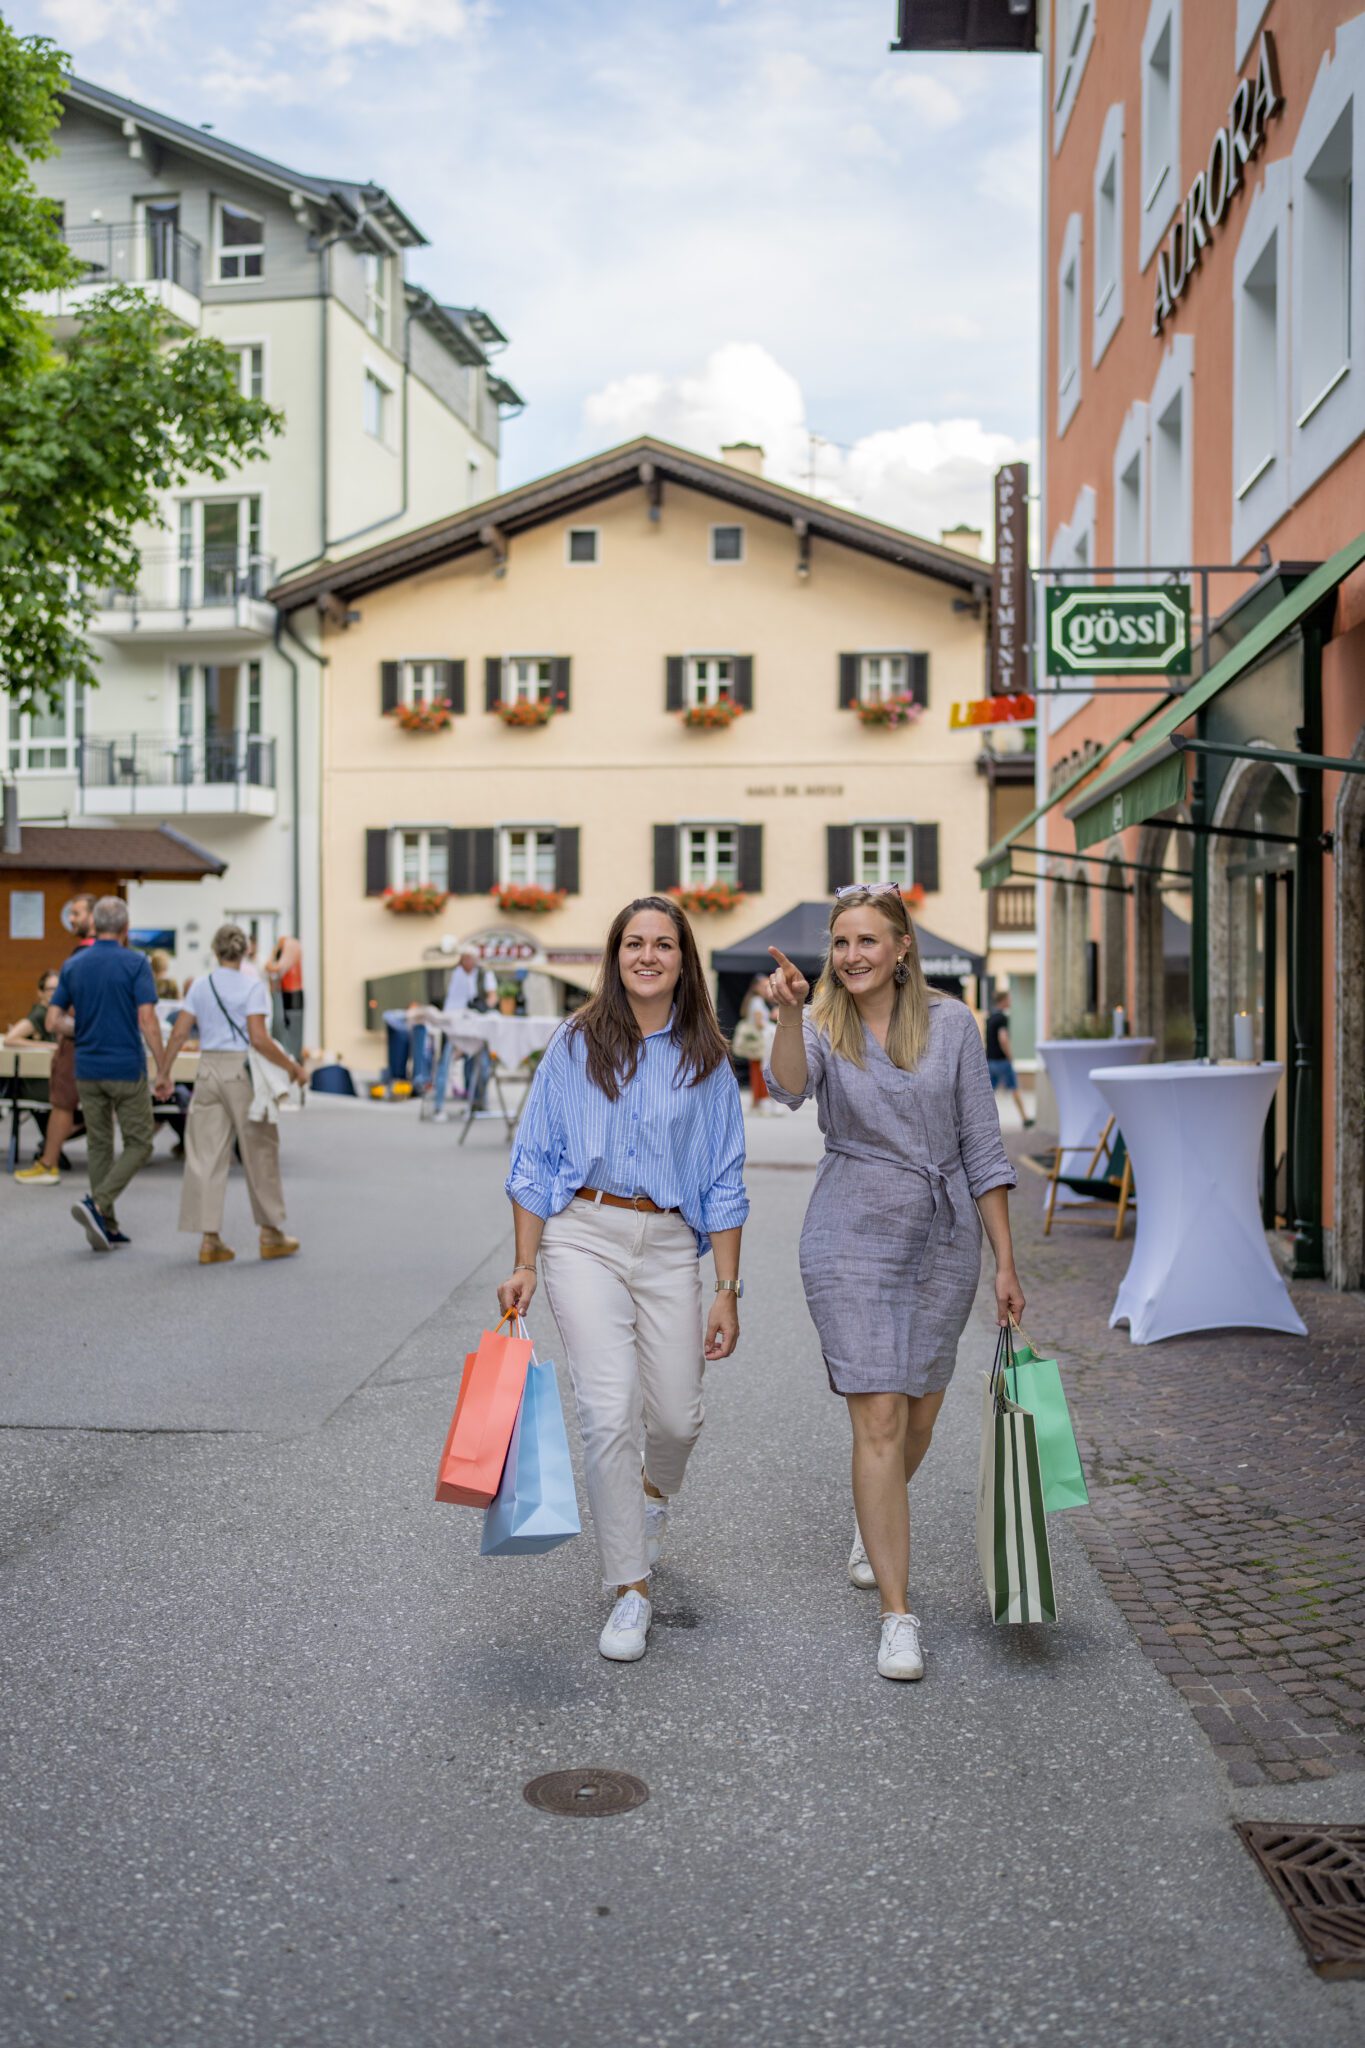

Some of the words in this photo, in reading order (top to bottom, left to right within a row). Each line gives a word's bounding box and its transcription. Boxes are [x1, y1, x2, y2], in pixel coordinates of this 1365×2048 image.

[1152, 29, 1286, 338] AURORA
[997, 466, 1016, 688] APPARTEMENT
[1068, 608, 1166, 656] gössl
